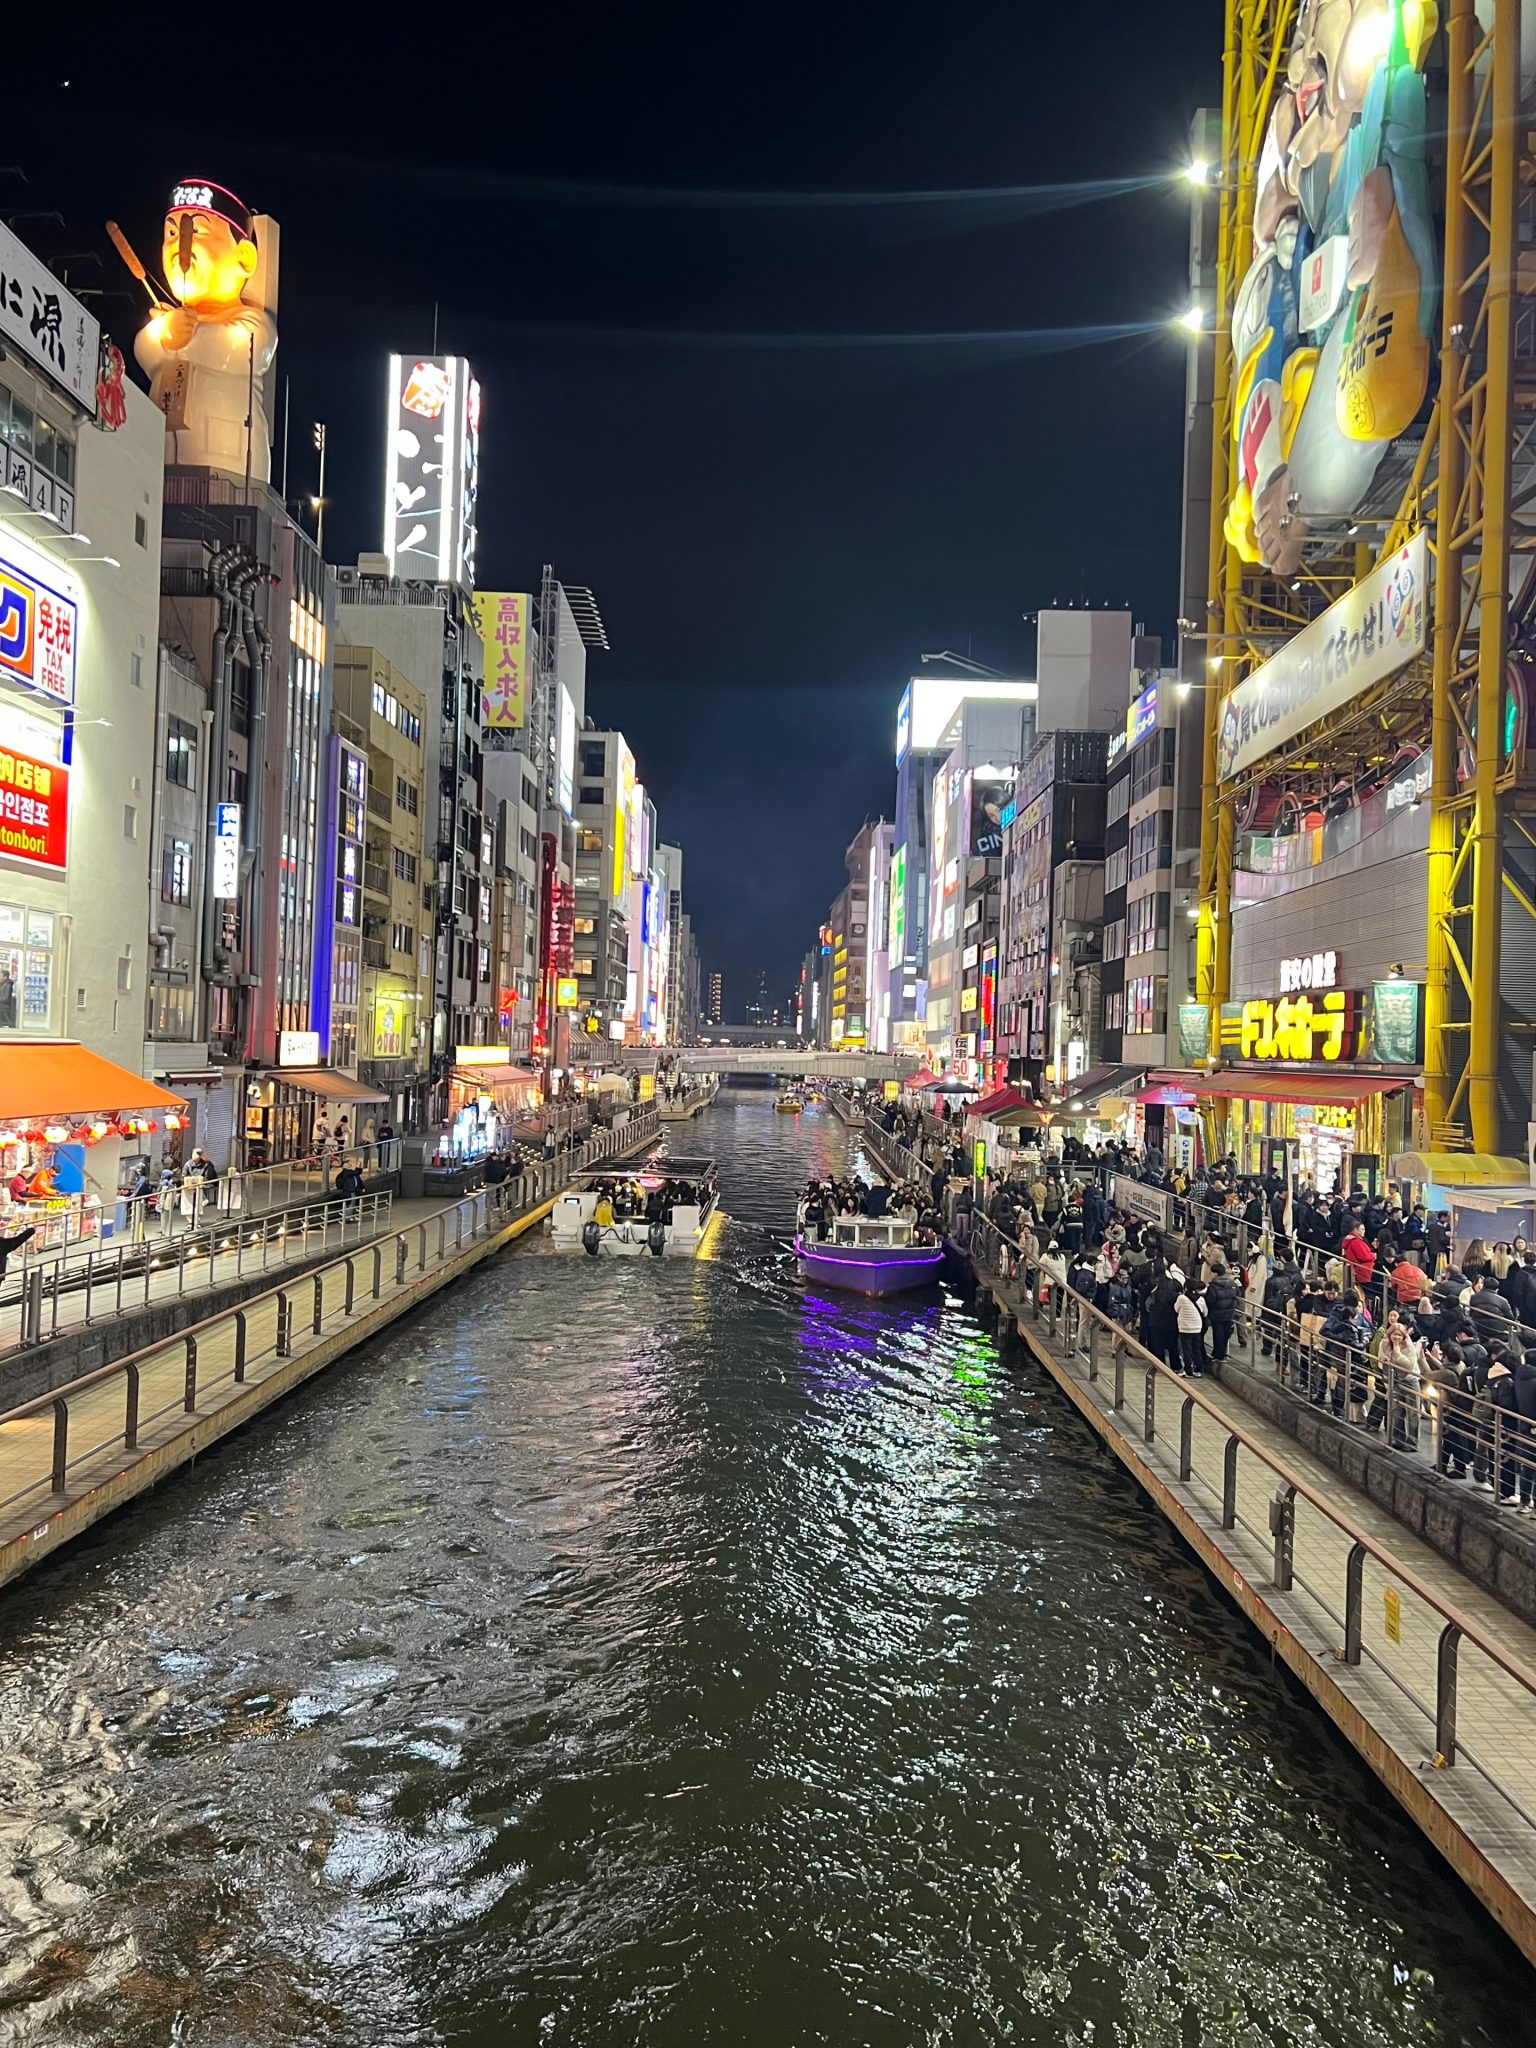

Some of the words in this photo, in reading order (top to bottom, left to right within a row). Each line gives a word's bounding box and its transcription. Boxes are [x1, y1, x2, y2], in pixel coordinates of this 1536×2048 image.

[38, 597, 71, 655] 免税
[45, 647, 63, 673] TAX
[495, 597, 521, 723] 高収入求人
[42, 667, 65, 695] FREE
[0, 826, 48, 855] tonbori.
[955, 1037, 967, 1059] 伝串
[953, 1060, 968, 1075] 50
